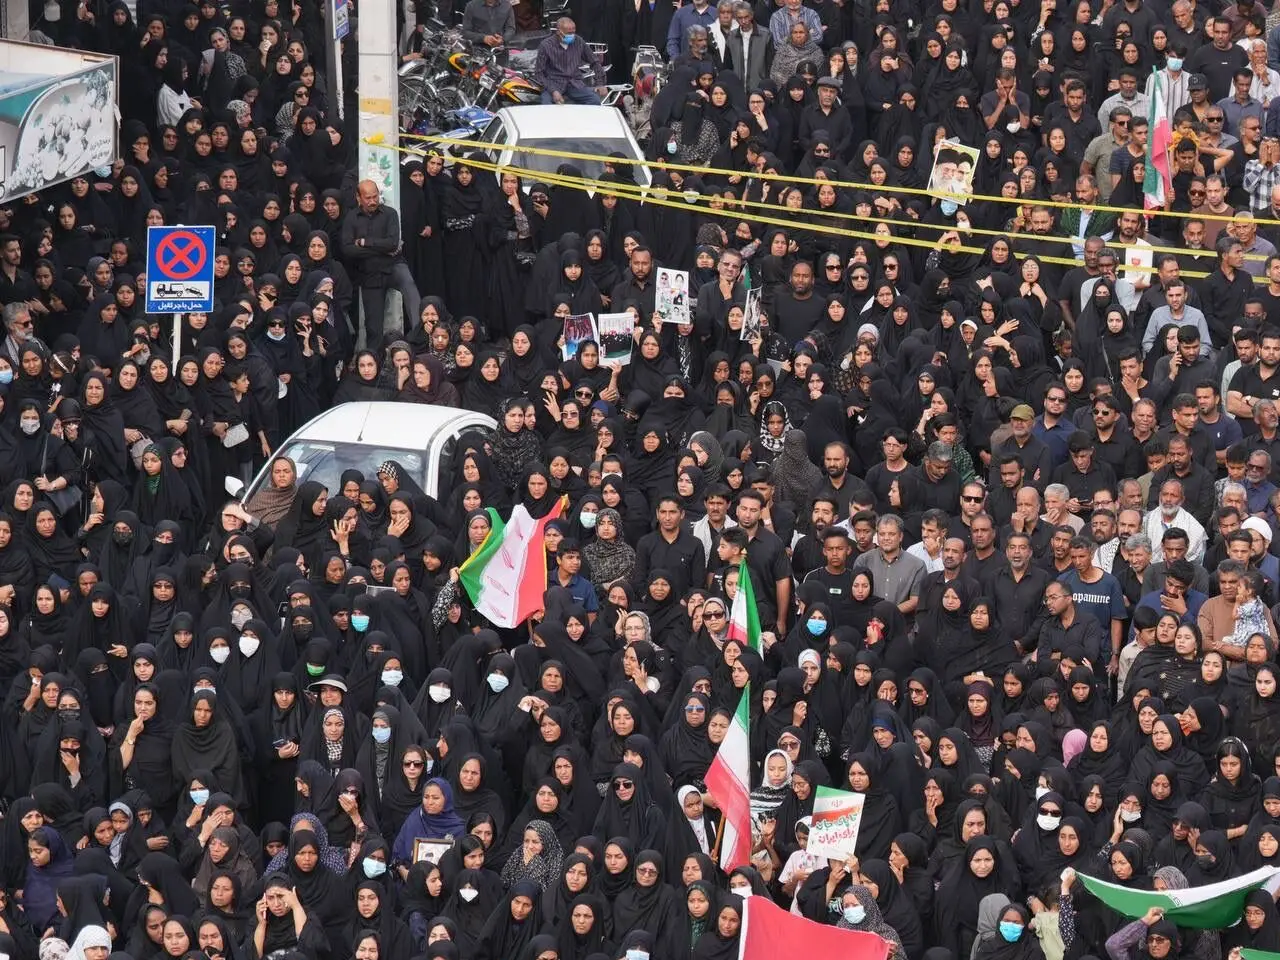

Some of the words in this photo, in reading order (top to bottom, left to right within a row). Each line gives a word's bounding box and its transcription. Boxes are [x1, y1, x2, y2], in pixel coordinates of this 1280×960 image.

[188, 301, 202, 310] حمل
[1072, 592, 1111, 604] opamine
[816, 819, 833, 831] جان
[818, 832, 838, 844] ایران
[842, 828, 856, 839] برای
